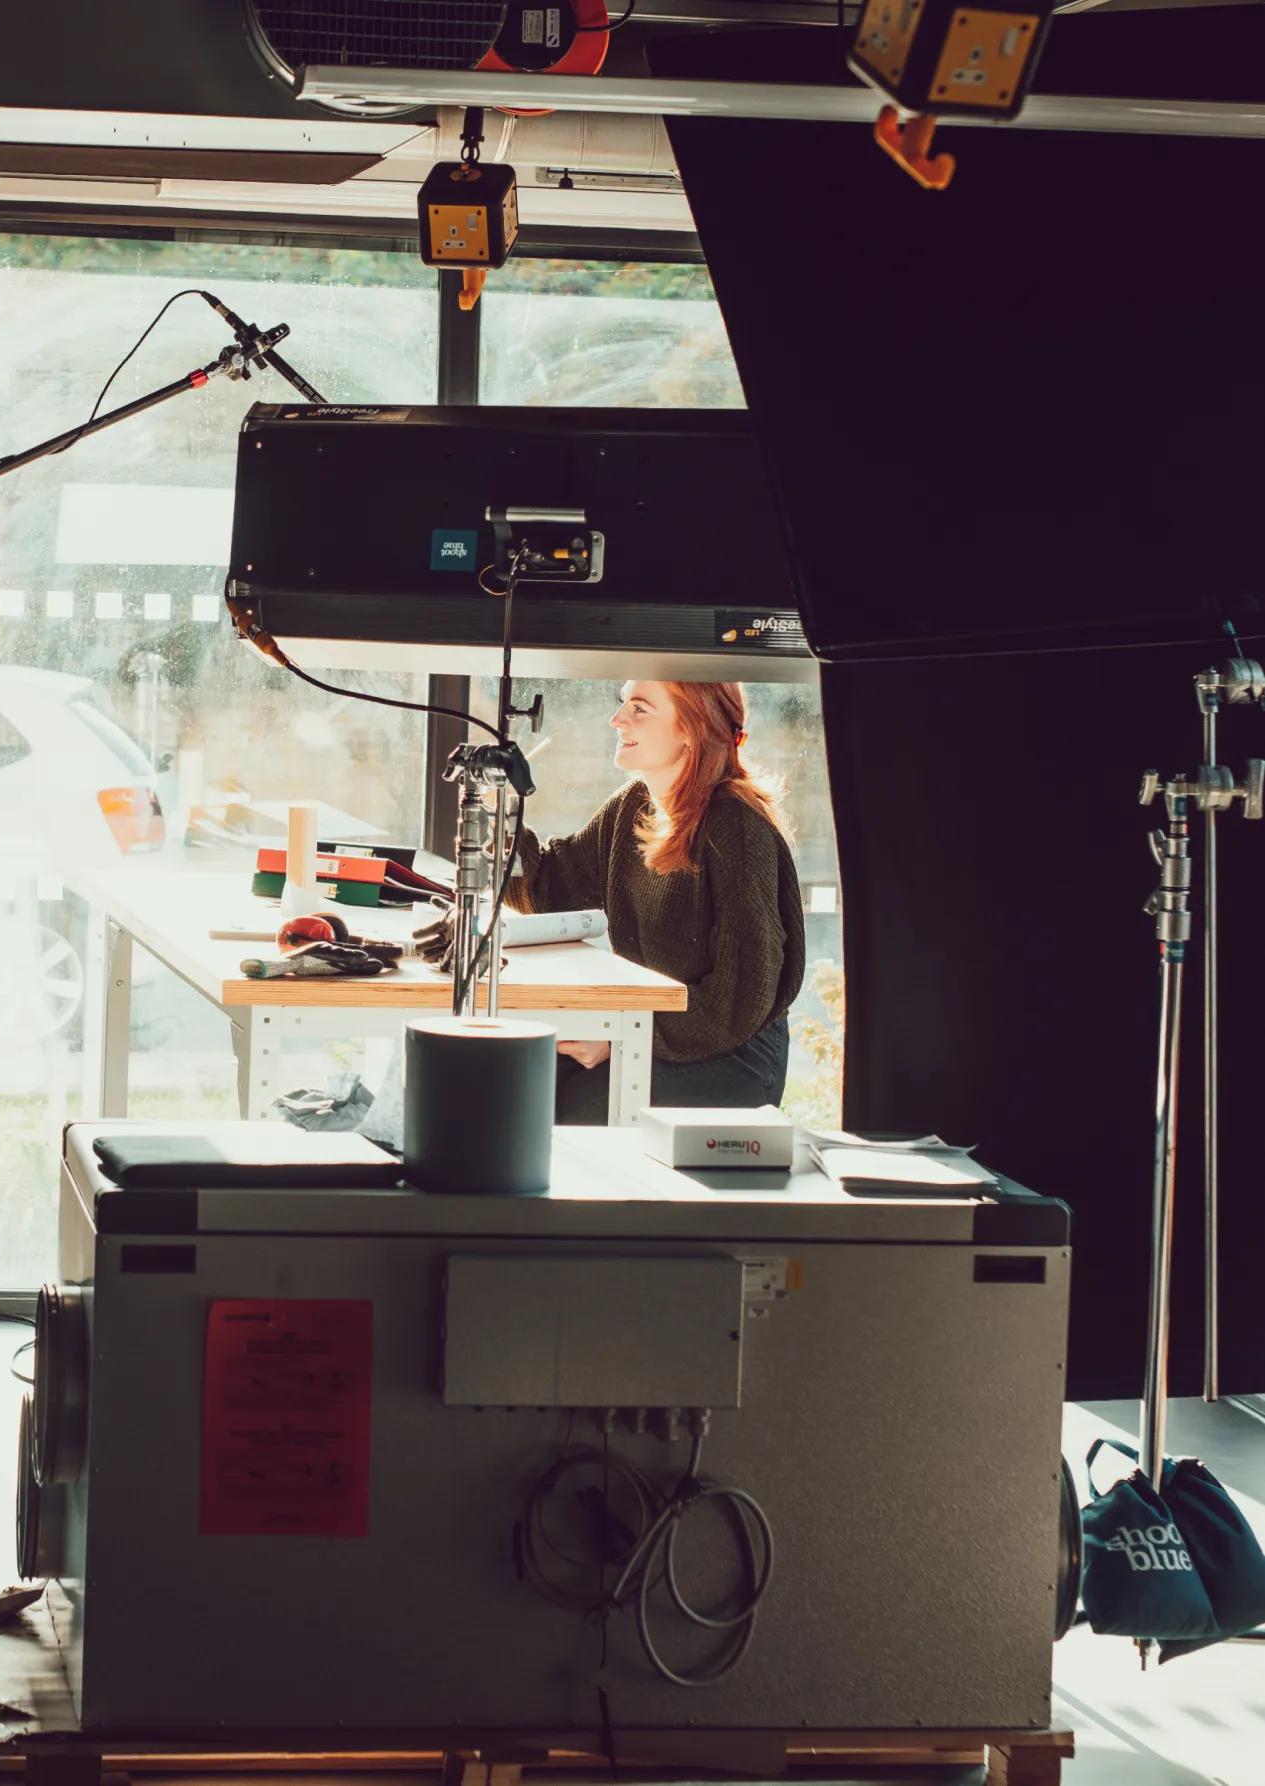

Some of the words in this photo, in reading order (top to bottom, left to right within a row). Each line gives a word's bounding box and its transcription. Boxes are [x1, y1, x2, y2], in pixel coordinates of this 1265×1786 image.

[441, 549, 467, 558] shoot
[444, 542, 464, 551] blue
[746, 1140, 761, 1156] IQ
[1105, 1524, 1185, 1551] shoo
[1126, 1542, 1193, 1571] blue
